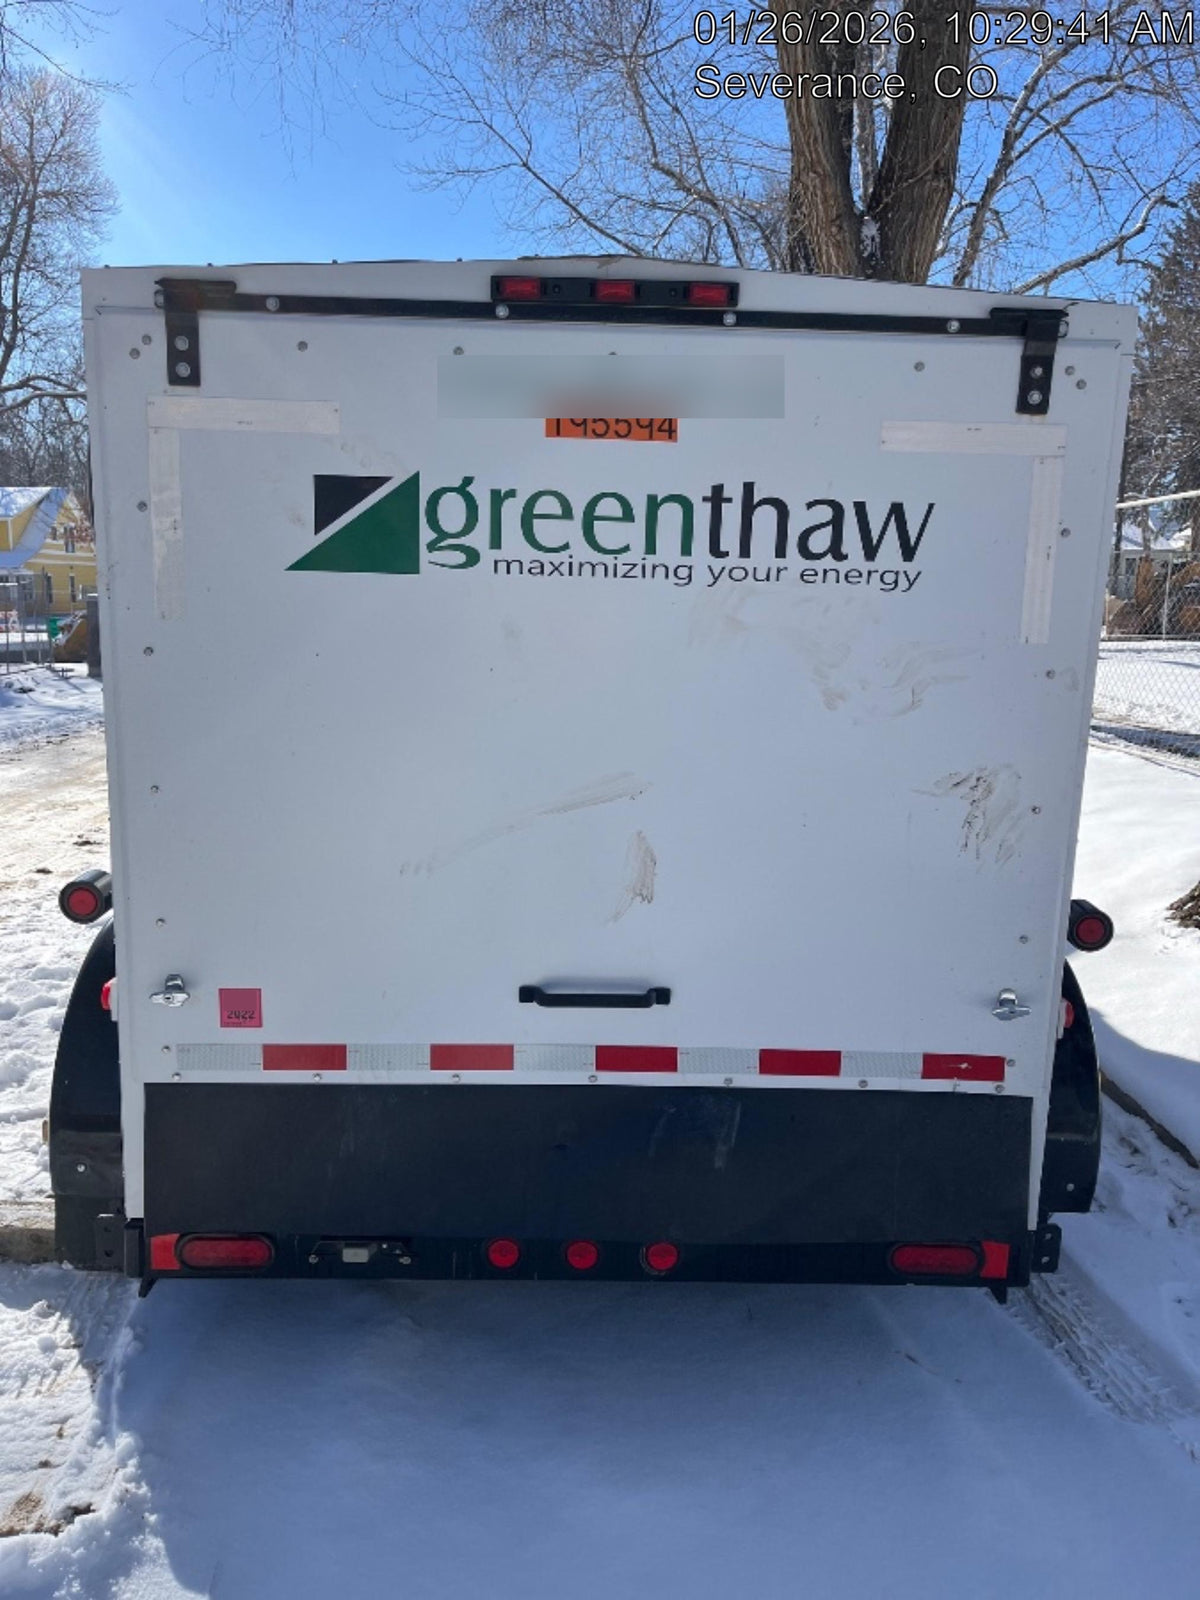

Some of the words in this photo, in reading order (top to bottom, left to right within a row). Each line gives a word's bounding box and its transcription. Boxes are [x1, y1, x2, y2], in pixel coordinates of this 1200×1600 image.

[425, 476, 935, 569] greenthaw
[493, 555, 694, 586] maximizing
[707, 564, 788, 587] your
[800, 566, 921, 592] energy
